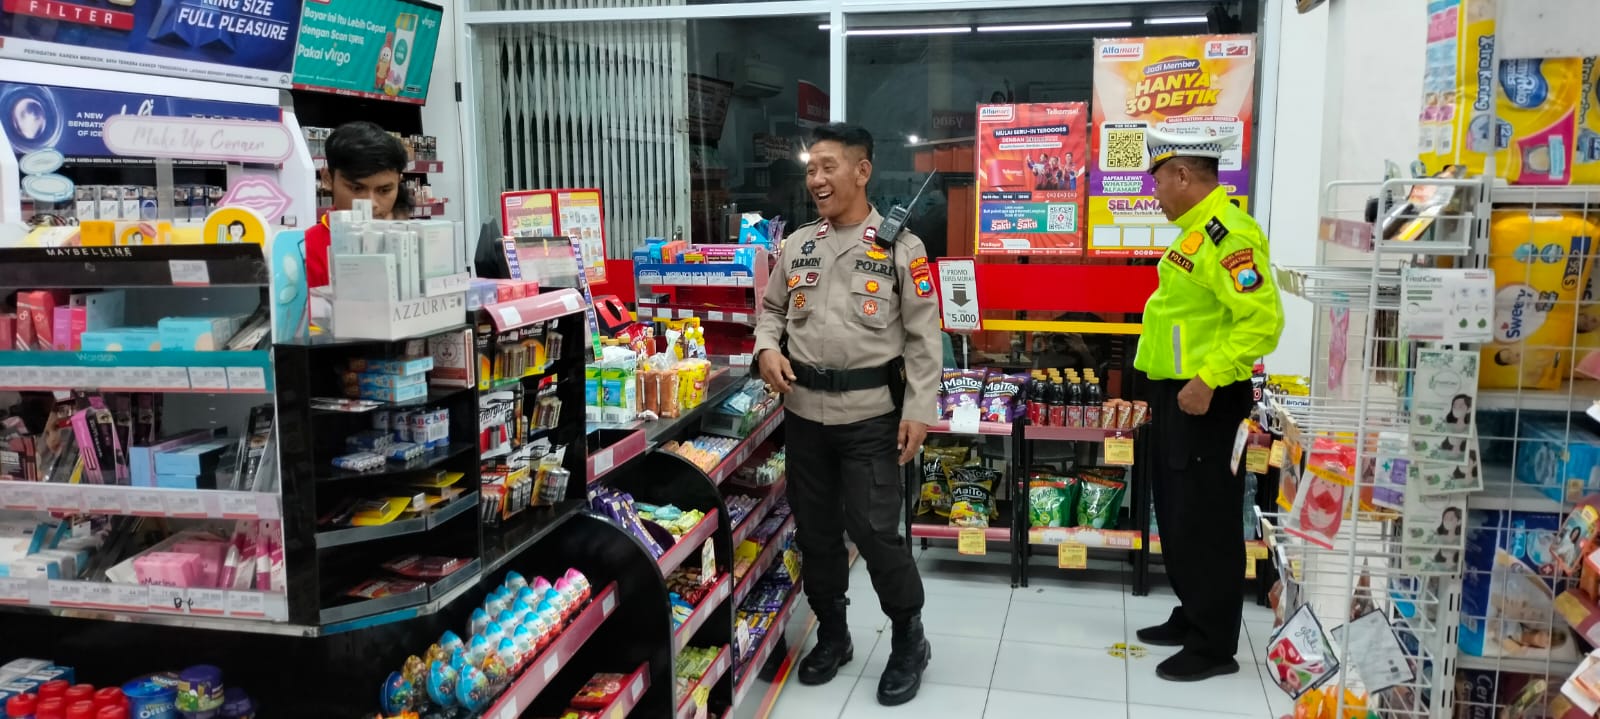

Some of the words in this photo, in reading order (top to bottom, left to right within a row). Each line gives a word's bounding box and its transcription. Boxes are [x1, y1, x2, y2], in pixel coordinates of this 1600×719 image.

[29, 0, 113, 25] FILTER
[242, 0, 274, 16] SIZE
[177, 7, 215, 29] FULL
[218, 15, 289, 41] PLEASURE
[304, 7, 326, 22] Bayar
[348, 16, 366, 28] Lebih
[366, 21, 387, 34] Cepat
[302, 24, 329, 39] dengan
[331, 30, 347, 42] Scan
[297, 44, 323, 60] Pakai
[325, 47, 351, 66] virgo
[1102, 45, 1140, 55] Alfamart
[1145, 63, 1162, 74] Jadi
[1163, 60, 1197, 71] Member
[1136, 71, 1211, 97] HANYA
[1126, 95, 1151, 115] 30
[1155, 88, 1223, 110] DETIK
[84, 112, 103, 120] NEW
[982, 107, 1009, 115] Alfamart
[1046, 107, 1079, 115] Telkomsel
[209, 129, 265, 151] Corner
[46, 247, 133, 257] MAYBELLINE
[854, 259, 894, 276] POLRI
[1170, 252, 1192, 270] POLISI
[393, 297, 449, 322] AZZURA
[951, 313, 977, 323] 5.000
[943, 377, 983, 390] MaiTos
[984, 381, 1020, 395] MaiTos
[411, 417, 432, 427] ABC
[952, 486, 987, 499] MaiTos
[139, 703, 176, 719] OREO
